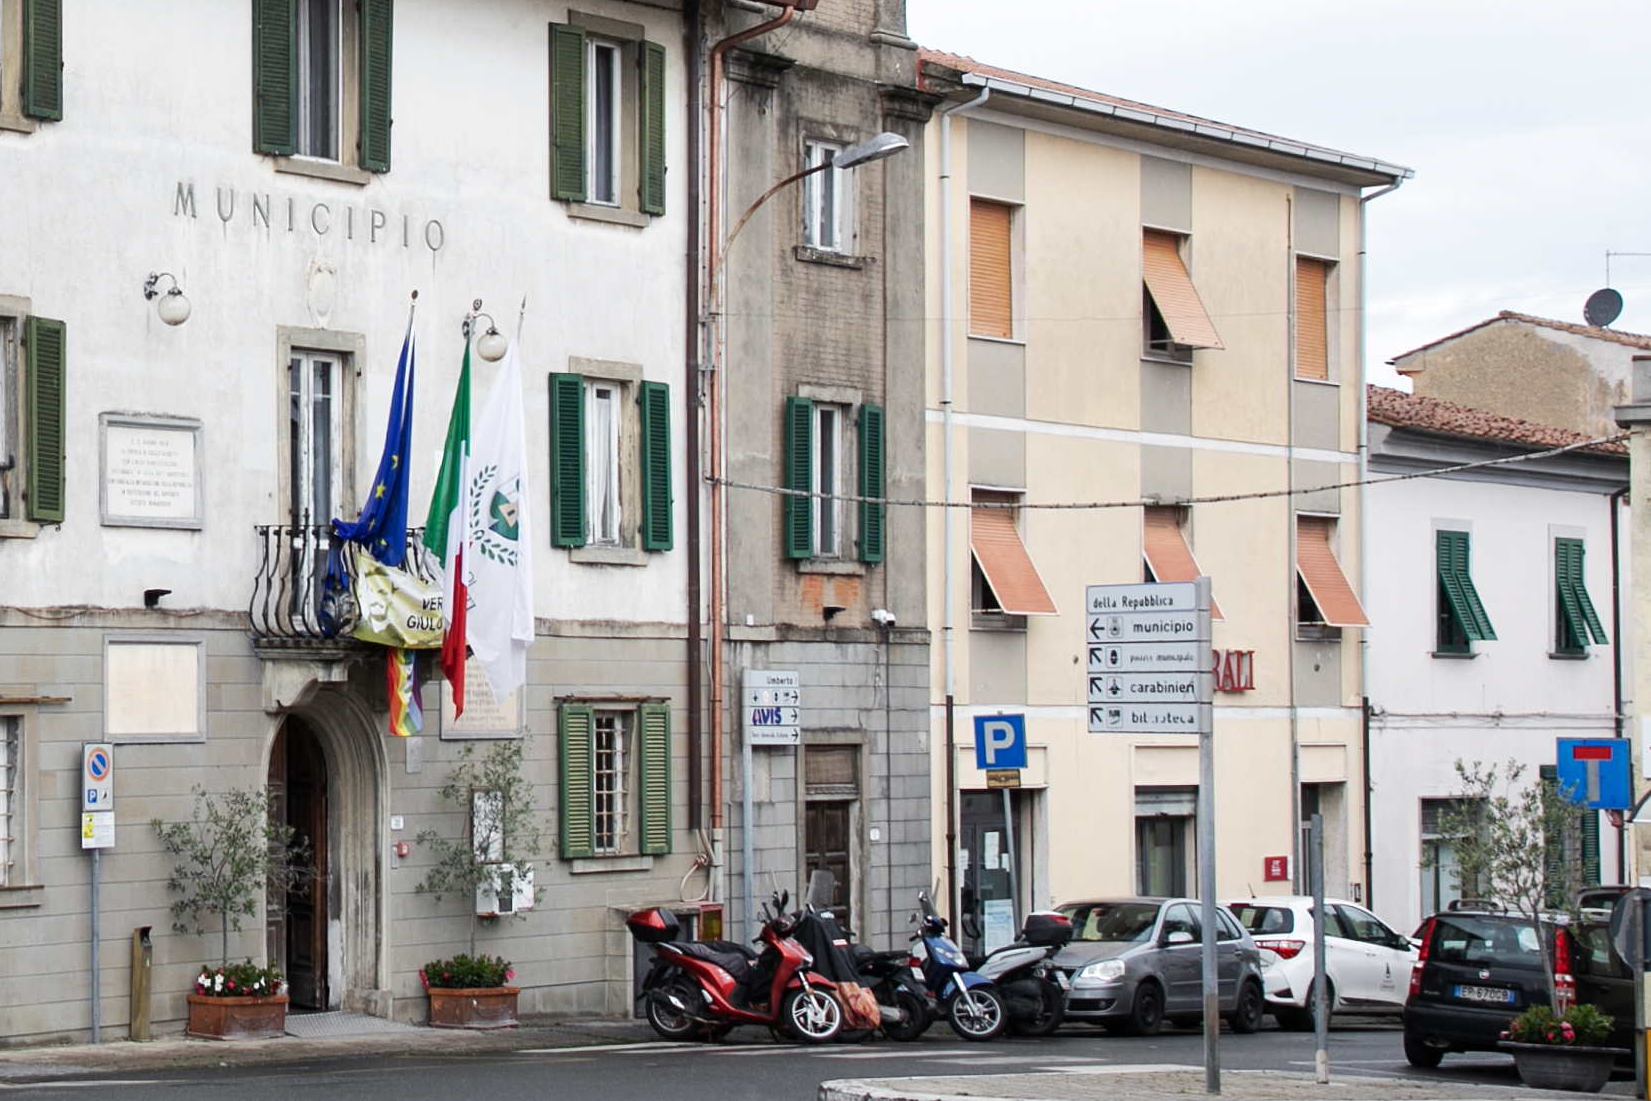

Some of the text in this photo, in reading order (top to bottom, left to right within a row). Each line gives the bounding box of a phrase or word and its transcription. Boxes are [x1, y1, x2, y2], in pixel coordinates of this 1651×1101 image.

[174, 181, 444, 252] MUNICIPIO
[1093, 595, 1174, 610] della Repubblica
[1132, 620, 1194, 634] municipio
[766, 676, 793, 685] Umberto
[1130, 681, 1195, 694] carabinieri
[752, 706, 782, 725] AVIS
[983, 720, 1015, 764] P
[89, 790, 96, 802] P
[1461, 986, 1473, 997] EP
